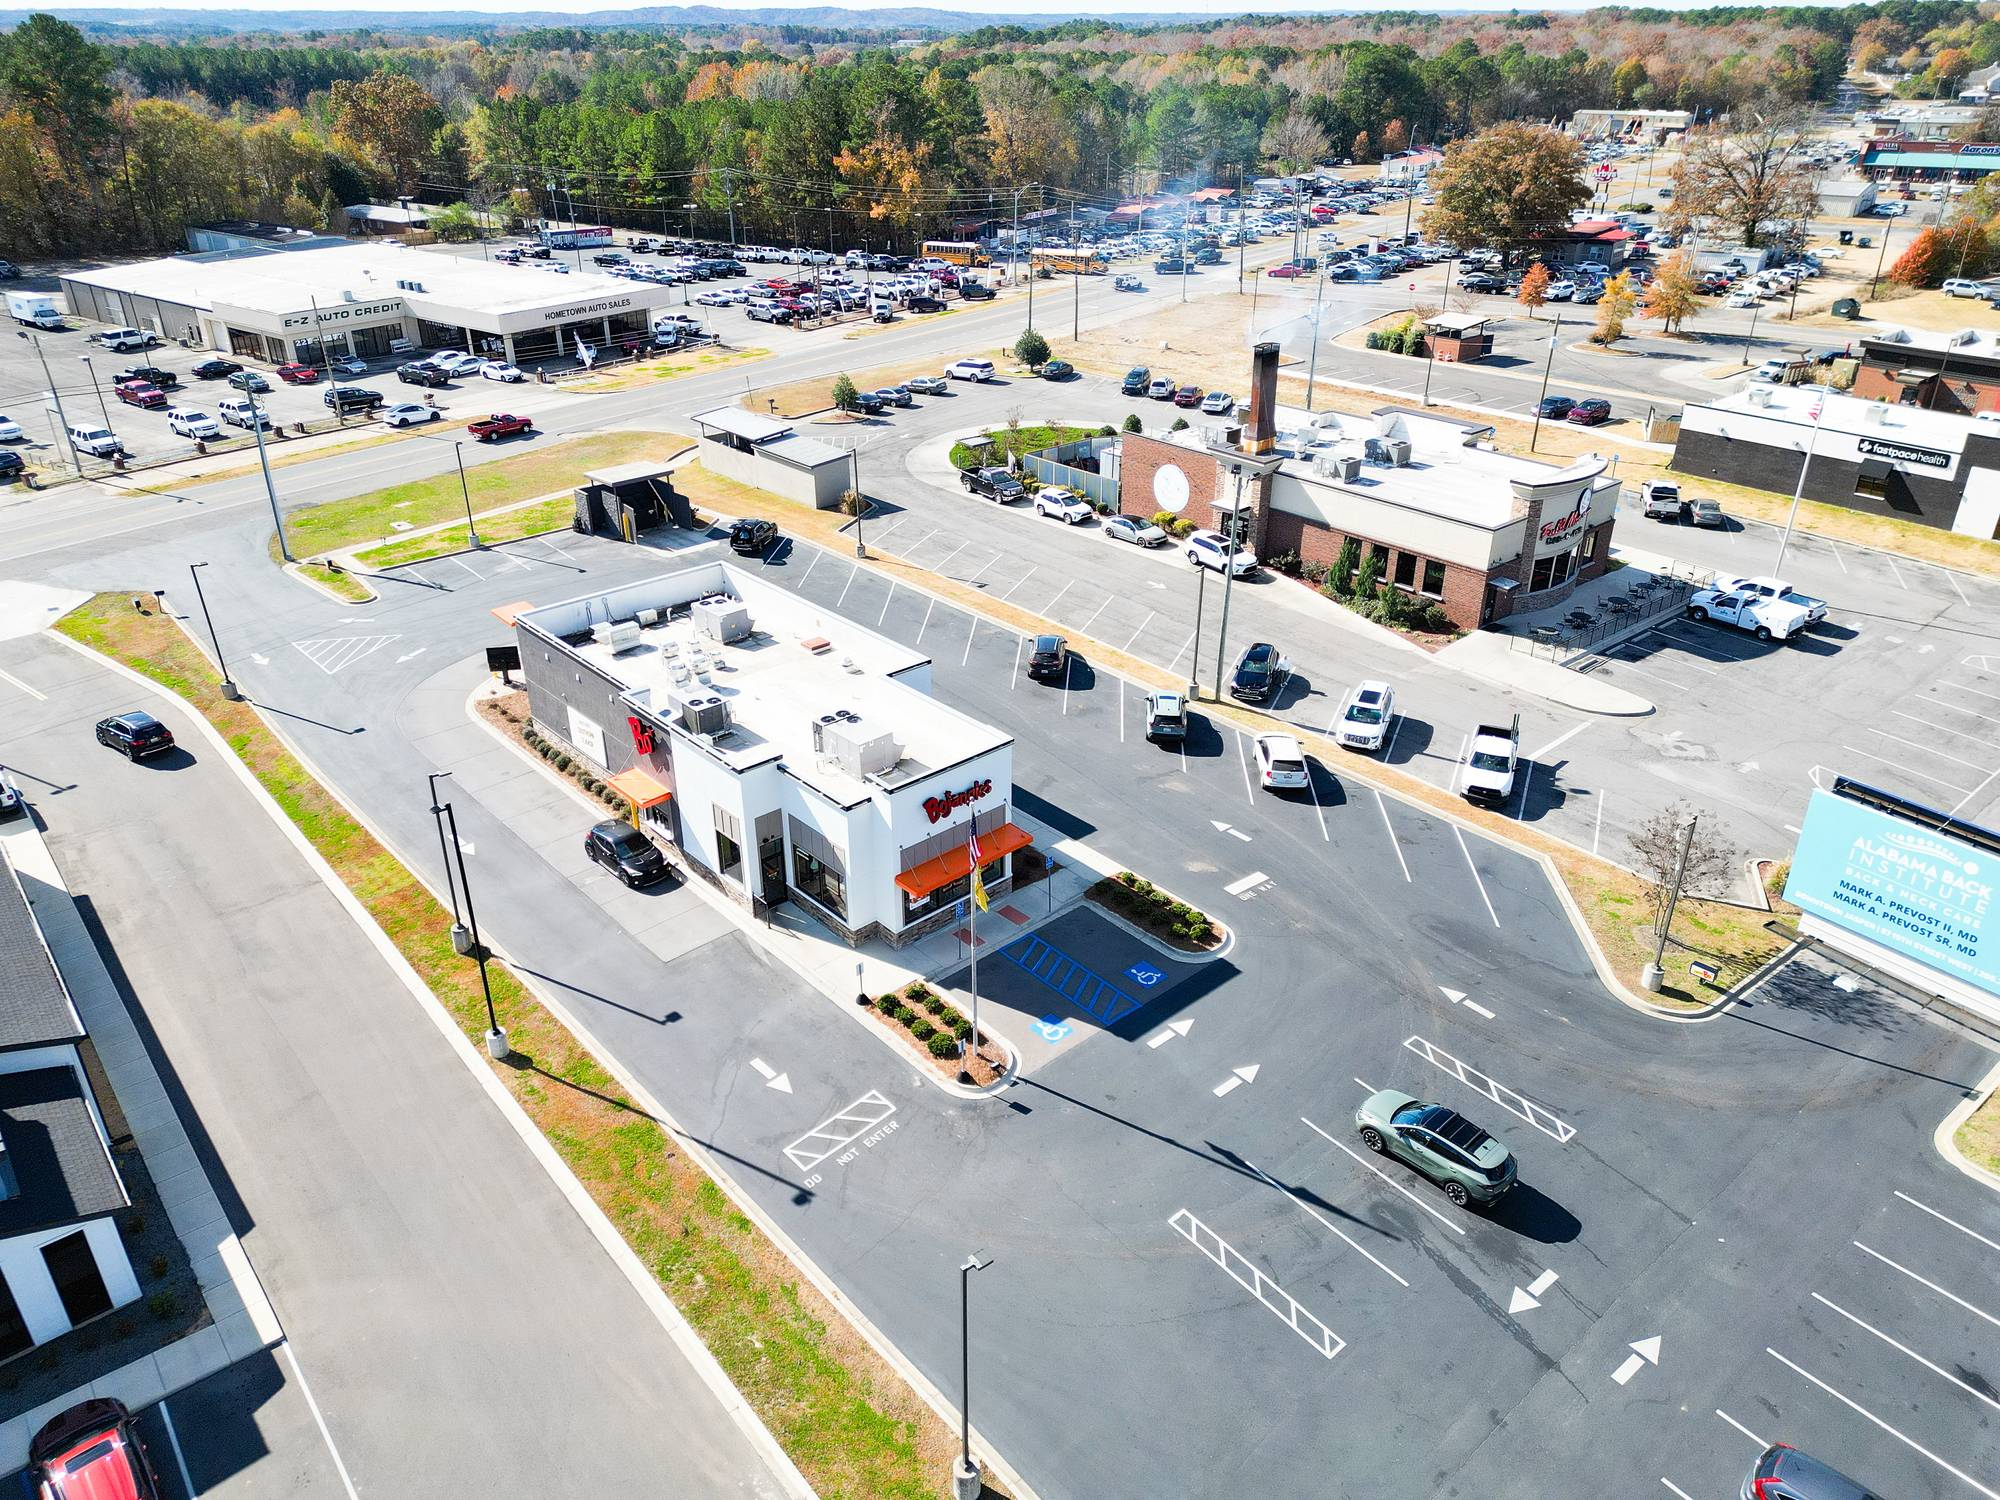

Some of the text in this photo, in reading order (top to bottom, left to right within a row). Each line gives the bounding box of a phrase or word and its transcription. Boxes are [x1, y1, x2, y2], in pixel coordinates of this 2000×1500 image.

[284, 302, 402, 327] E-Z AUTO CREDIT
[544, 298, 631, 320] HOMETOWN AUTO SALES
[1845, 866, 1880, 887] BACK
[1943, 907, 1981, 929] CARE
[1848, 847, 1990, 915] INSTITUTE
[1853, 836, 1993, 901] ALABAMA BACK
[1832, 890, 1866, 910] MARK
[1867, 906, 1879, 916] A.
[1882, 911, 1934, 938] PREVOST
[1935, 934, 1952, 949] SR,
[1956, 943, 1977, 957] MD
[1839, 879, 1874, 899] MARK
[1874, 895, 1886, 906] A.
[1889, 900, 1941, 927] PREVOST
[1957, 929, 1978, 943] MD
[803, 1120, 900, 1189] DO NOT ENTER
